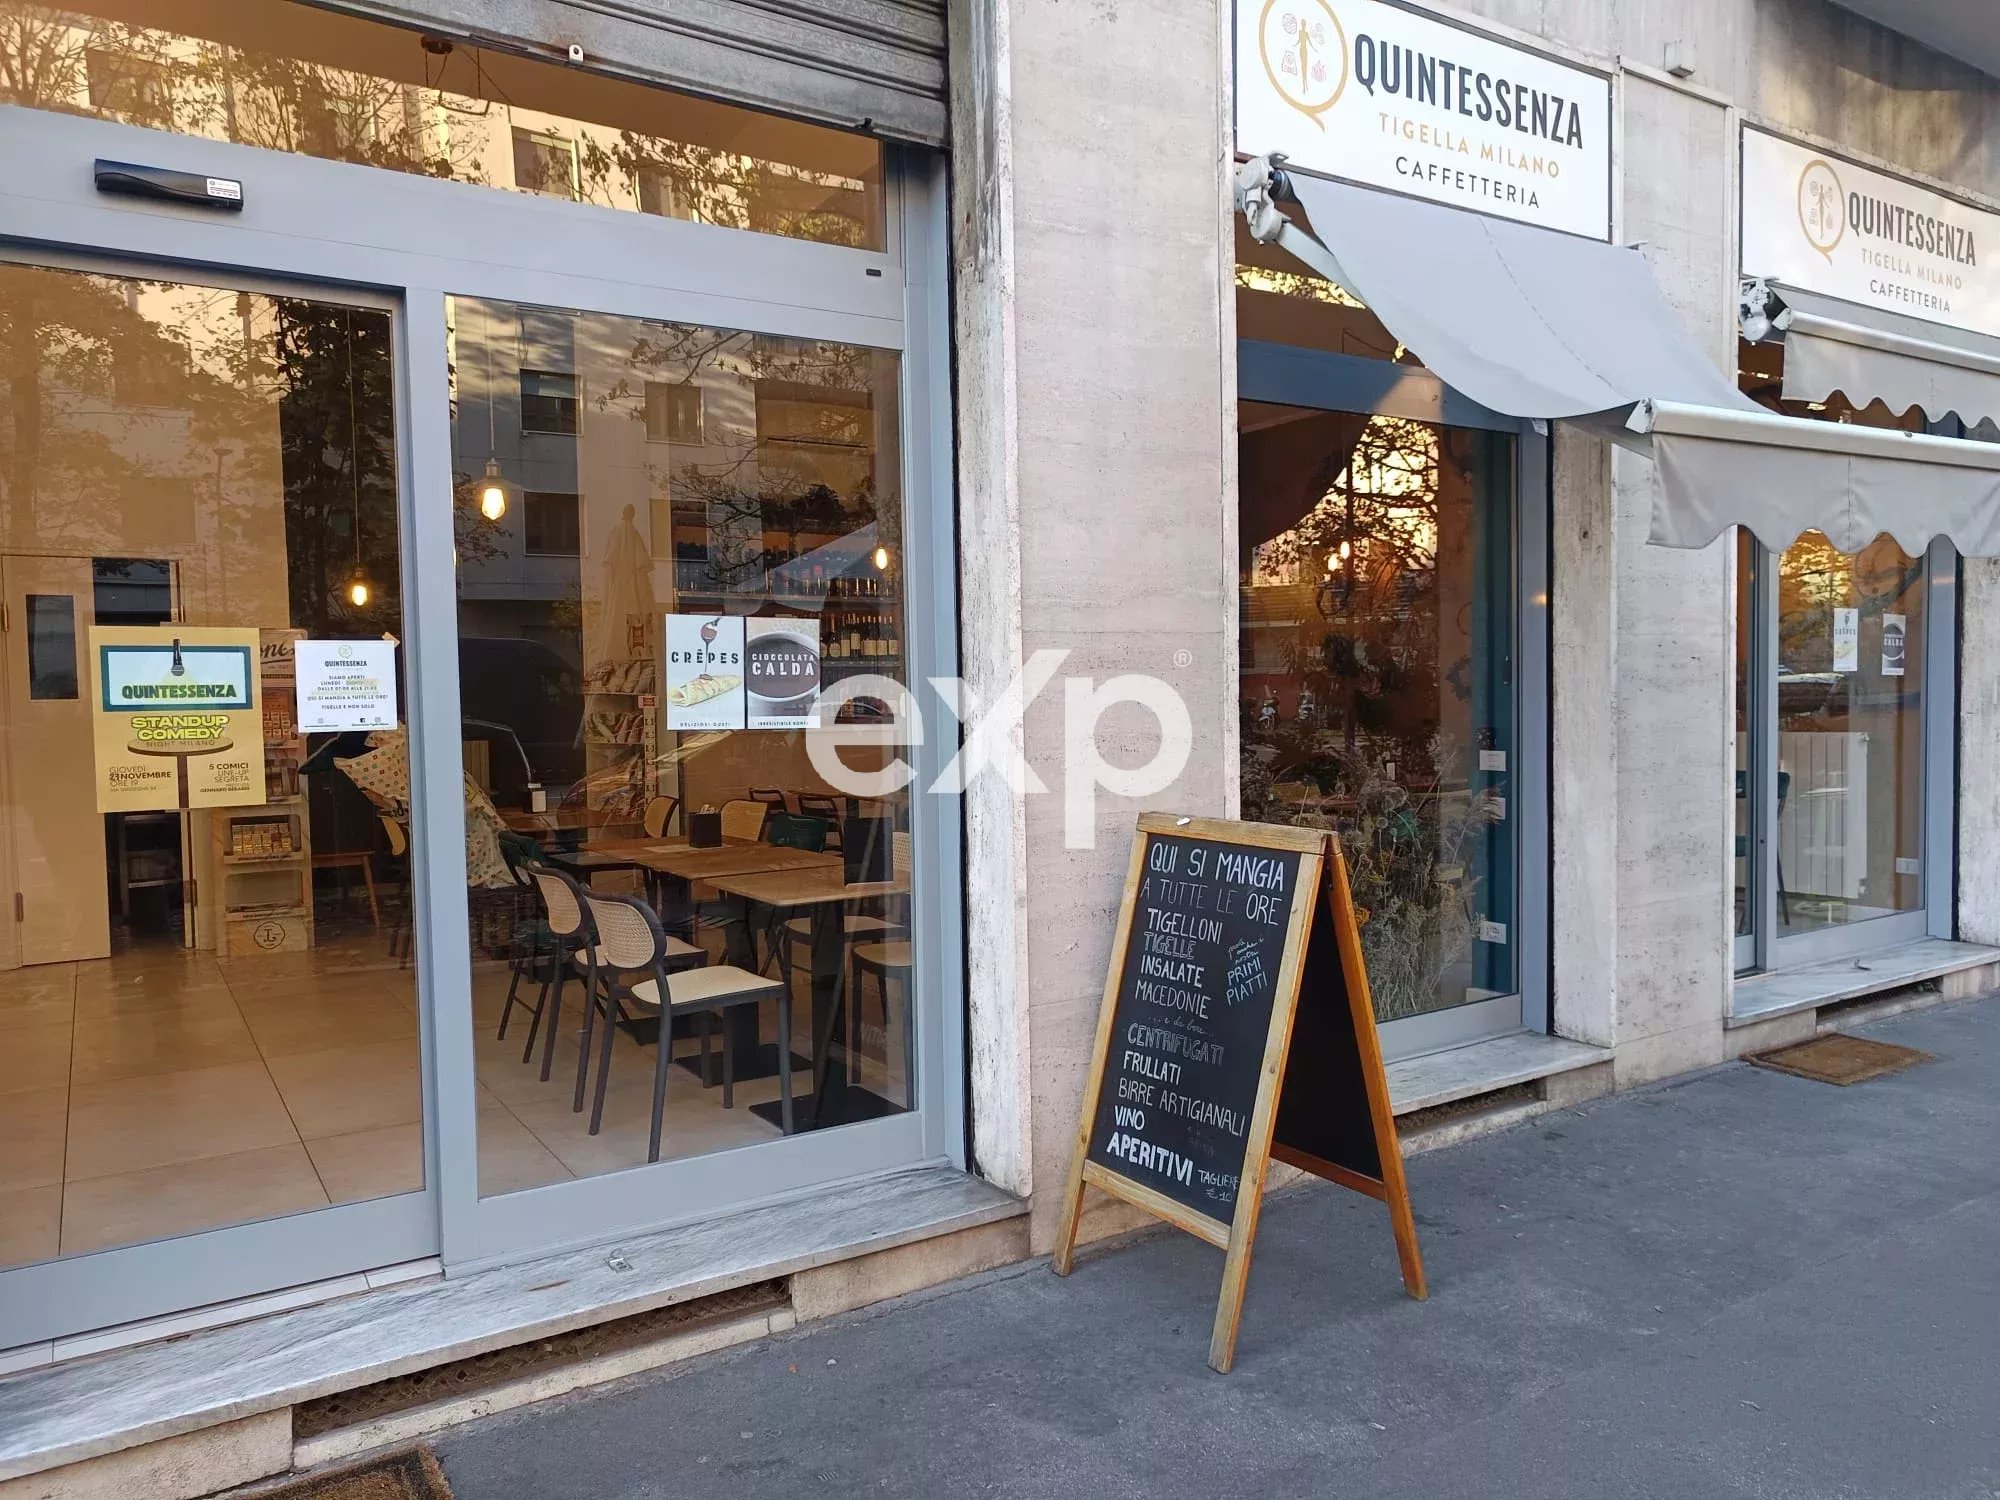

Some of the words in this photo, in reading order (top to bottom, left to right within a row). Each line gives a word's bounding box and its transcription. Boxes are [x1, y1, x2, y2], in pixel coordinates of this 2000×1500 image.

[1355, 34, 1583, 149] QUINTESSENZA
[1379, 112, 1469, 154] TIGELLA
[1480, 141, 1560, 178] MILANO
[1396, 156, 1539, 208] CAFFETTERIA
[1849, 192, 1976, 266] QUINTESSENZA
[1861, 248, 1912, 275] TIGELLA
[1916, 265, 1962, 290] MILANO
[1870, 280, 1951, 312] CAFFETTERIA
[671, 649, 739, 665] CRÊPES
[752, 653, 815, 661] CIOCCOLATA
[752, 662, 815, 676] CALDA
[121, 684, 237, 699] QUINTESSENZA
[130, 715, 230, 729] STANDUP
[137, 727, 223, 741] COMEDY
[146, 740, 175, 748] NIGHT
[179, 739, 216, 747] MILANO
[120, 771, 172, 780] NOVEMBRE
[217, 762, 249, 770] COMICI
[1150, 842, 1178, 873] QUI
[1187, 848, 1207, 877] SI
[1215, 851, 1284, 892] MANGIA
[1140, 877, 1150, 900] A
[1160, 878, 1208, 909] TUTTE
[1216, 888, 1239, 914] LE
[1246, 893, 1282, 926] ORE
[1147, 907, 1223, 944] TIGELLONI
[1143, 931, 1196, 960] TIGELLE
[1140, 954, 1205, 988] INSALATE
[1227, 956, 1262, 986] PRIMI
[1135, 979, 1212, 1020] MACEDONIE
[1226, 971, 1268, 1006] PIATTI
[1127, 1022, 1224, 1067] CENTRIFUGATI
[1123, 1050, 1181, 1085] FRULLATI
[1115, 1105, 1145, 1130] VINO
[1118, 1077, 1155, 1106] BIRRE
[1159, 1089, 1246, 1137] ARTIGIANALI
[1106, 1131, 1194, 1186] APERITIVI
